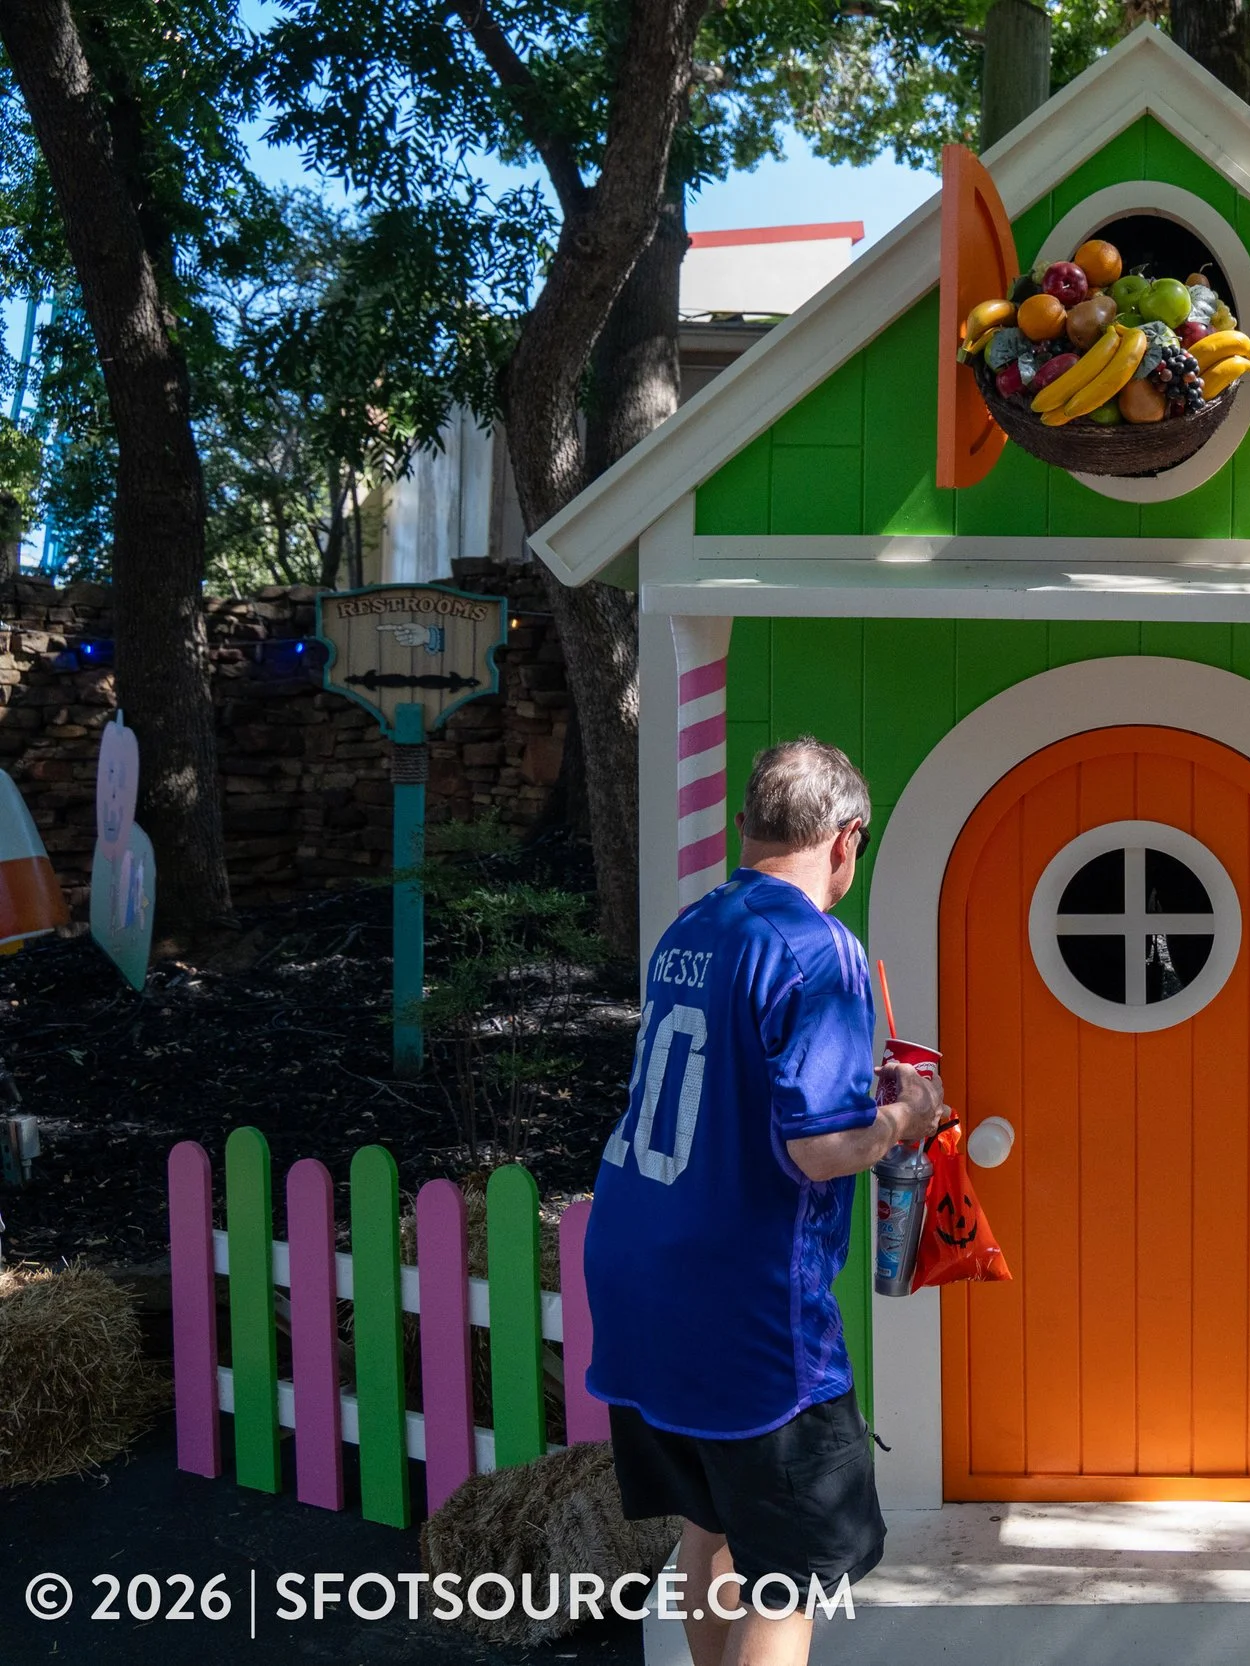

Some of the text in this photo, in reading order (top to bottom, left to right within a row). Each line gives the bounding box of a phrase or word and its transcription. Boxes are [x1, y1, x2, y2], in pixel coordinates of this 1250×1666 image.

[337, 598, 488, 621] RESTROOMS
[653, 949, 713, 988] MESSI
[603, 1001, 708, 1186] 10
